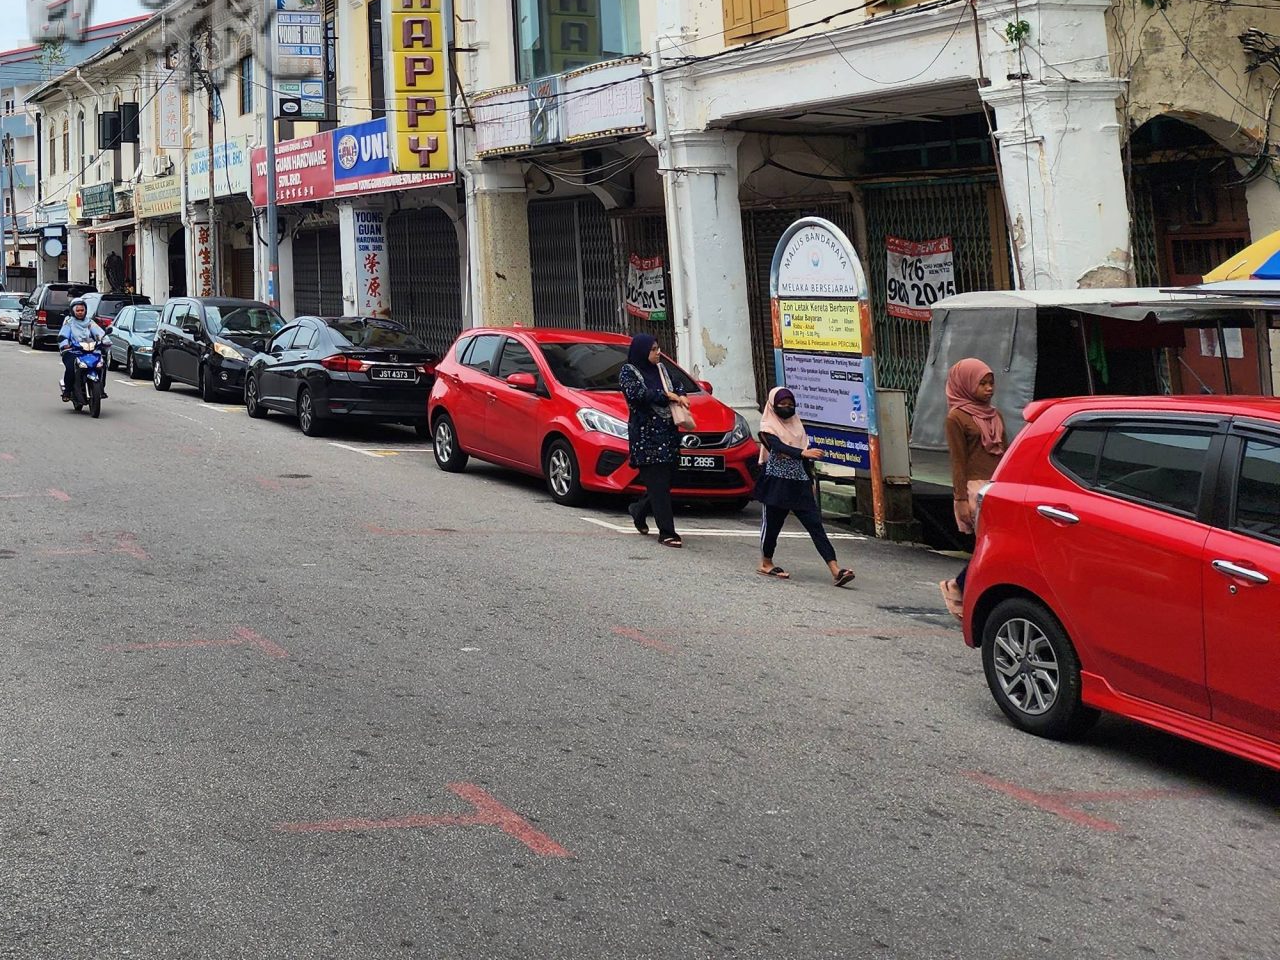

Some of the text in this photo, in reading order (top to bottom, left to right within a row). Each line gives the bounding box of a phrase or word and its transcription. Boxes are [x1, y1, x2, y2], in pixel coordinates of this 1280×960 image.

[355, 211, 384, 223] YOONG
[358, 224, 382, 236] GUAN
[356, 236, 385, 244] HARDWARE
[784, 237, 804, 270] MAJLIS
[804, 232, 847, 270] BANDARAYA
[901, 257, 925, 281] 016
[782, 283, 854, 293] MELAKA BERSEJARAH
[910, 281, 956, 306] 2015
[783, 302, 855, 314] Zon Letak Kereta Berbayar
[791, 313, 822, 323] Kadar Bayaran
[379, 370, 408, 378] JST 4373
[693, 456, 715, 467] 2895
[829, 450, 846, 462] Parking
